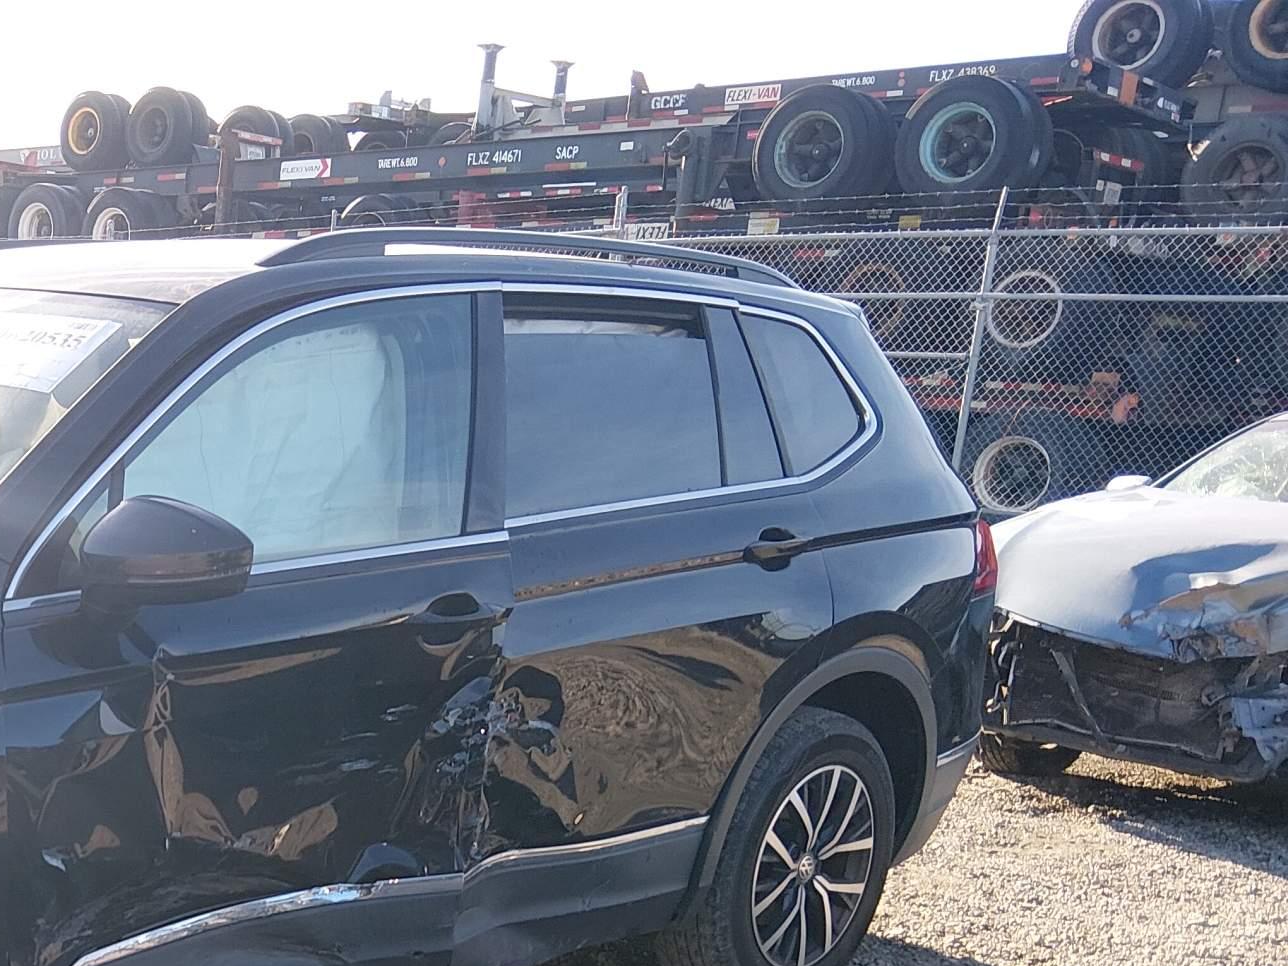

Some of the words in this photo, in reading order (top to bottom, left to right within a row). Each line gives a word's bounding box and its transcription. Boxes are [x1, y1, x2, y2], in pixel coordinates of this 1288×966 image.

[725, 86, 780, 103] FLEXI-VAN
[467, 151, 490, 166] FLXZ
[492, 149, 522, 164] 414671
[555, 145, 579, 160] SACP
